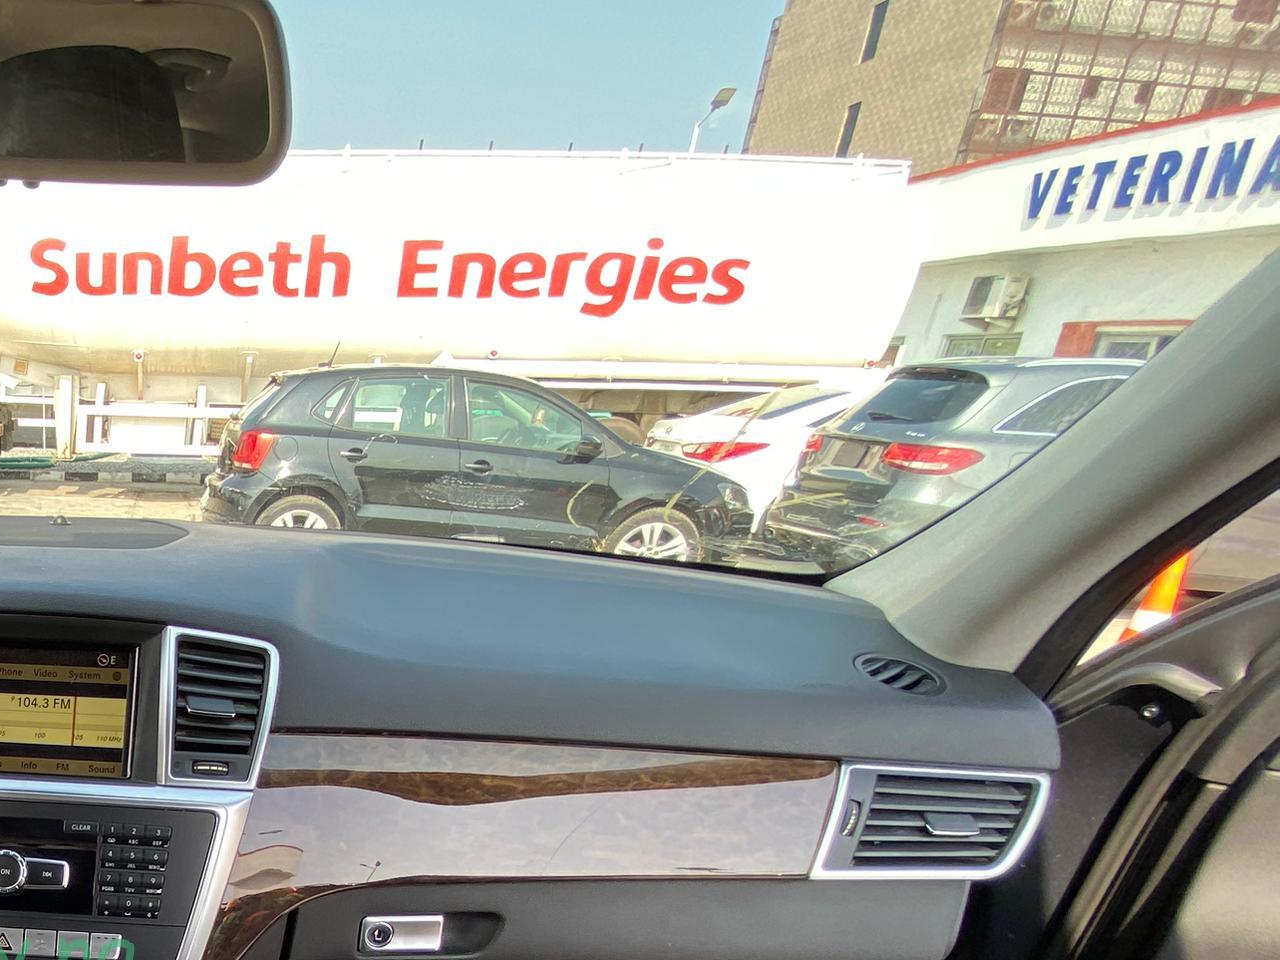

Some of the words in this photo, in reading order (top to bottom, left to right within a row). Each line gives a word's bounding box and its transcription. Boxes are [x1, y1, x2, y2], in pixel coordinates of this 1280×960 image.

[1027, 134, 1280, 219] VETERINA
[30, 234, 351, 298] Sunbeth
[396, 237, 752, 318] Energies
[109, 655, 117, 665] E
[33, 668, 58, 678] Video
[68, 670, 101, 682] System
[53, 699, 71, 710] FM
[21, 761, 38, 770] Info
[56, 762, 70, 771] FM
[88, 765, 116, 775] Sound
